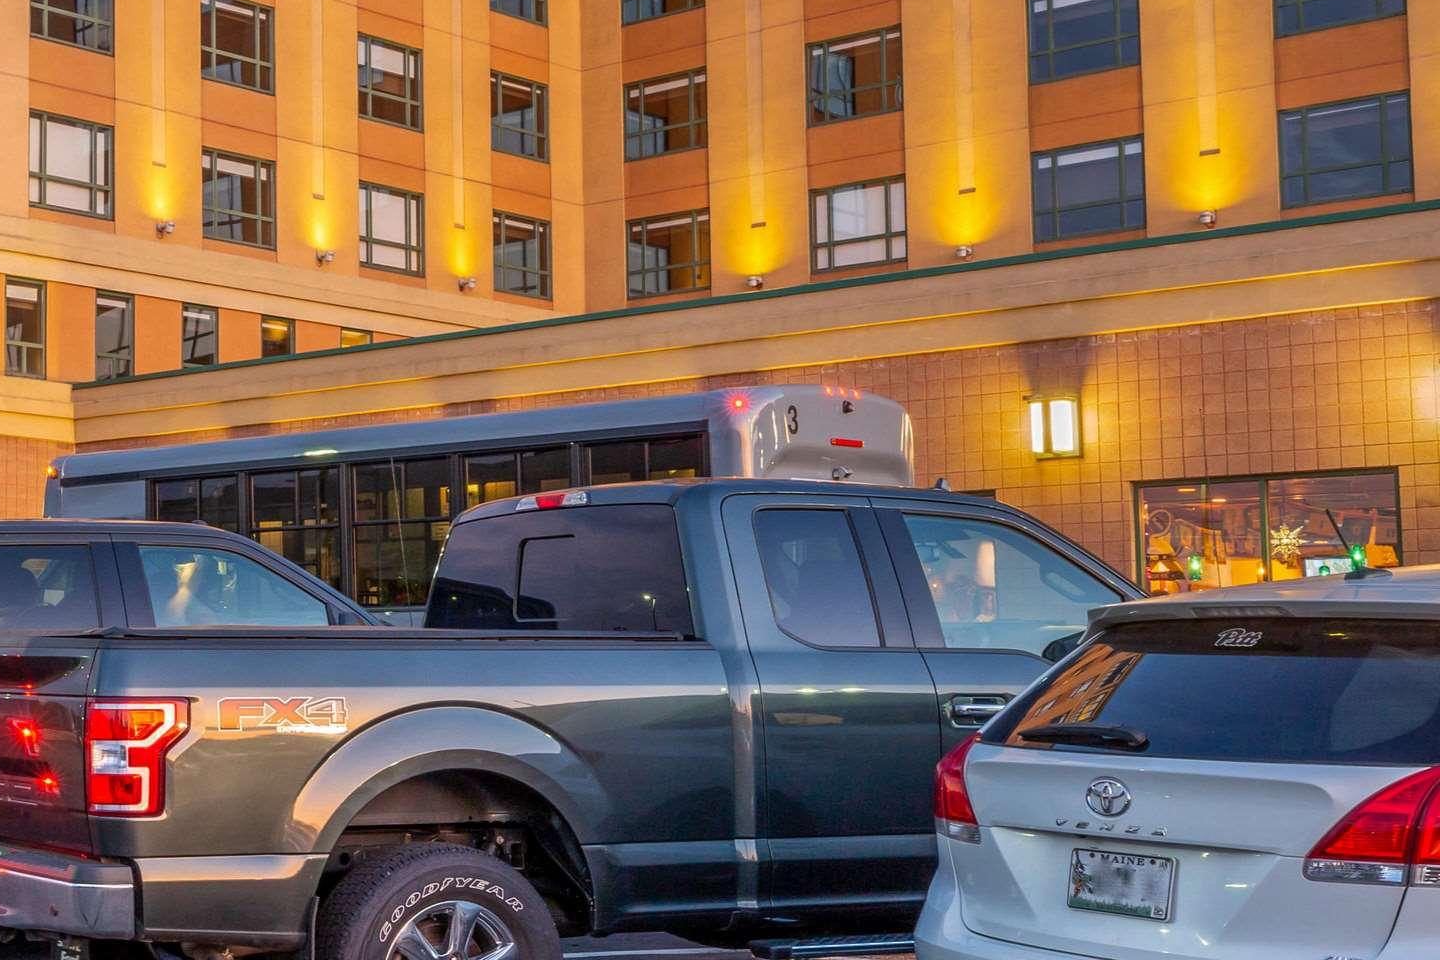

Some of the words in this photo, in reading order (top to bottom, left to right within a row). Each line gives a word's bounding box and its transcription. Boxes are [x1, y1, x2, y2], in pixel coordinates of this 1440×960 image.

[787, 405, 799, 435] 3
[1214, 627, 1263, 647] Pitt
[217, 697, 348, 732] FX4
[1055, 817, 1168, 837] VENZA
[1100, 853, 1145, 866] MAINE
[379, 877, 524, 942] GOODYEAR
